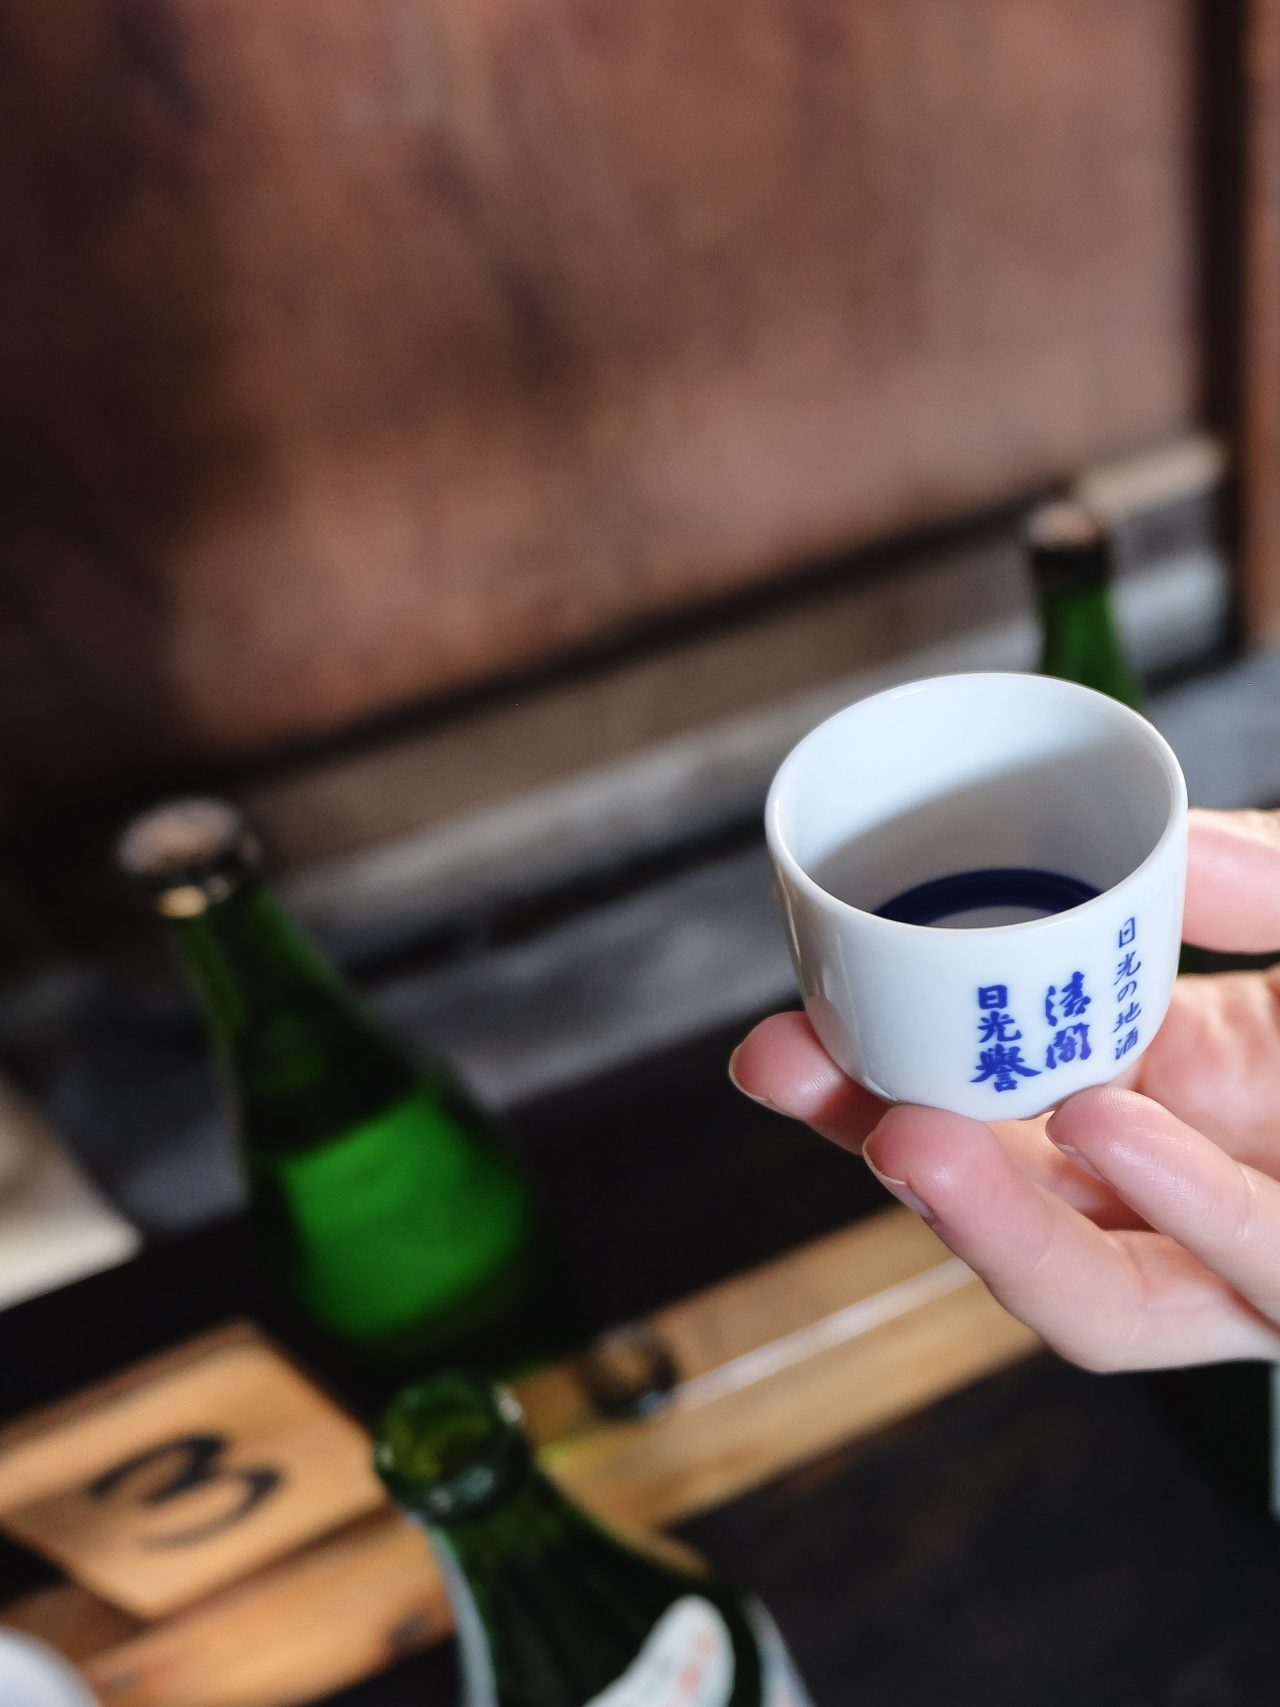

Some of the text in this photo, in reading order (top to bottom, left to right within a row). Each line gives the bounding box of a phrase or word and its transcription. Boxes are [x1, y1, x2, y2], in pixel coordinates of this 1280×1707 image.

[1113, 916, 1142, 1061] 日光の地酒
[86, 1432, 285, 1554] 3
